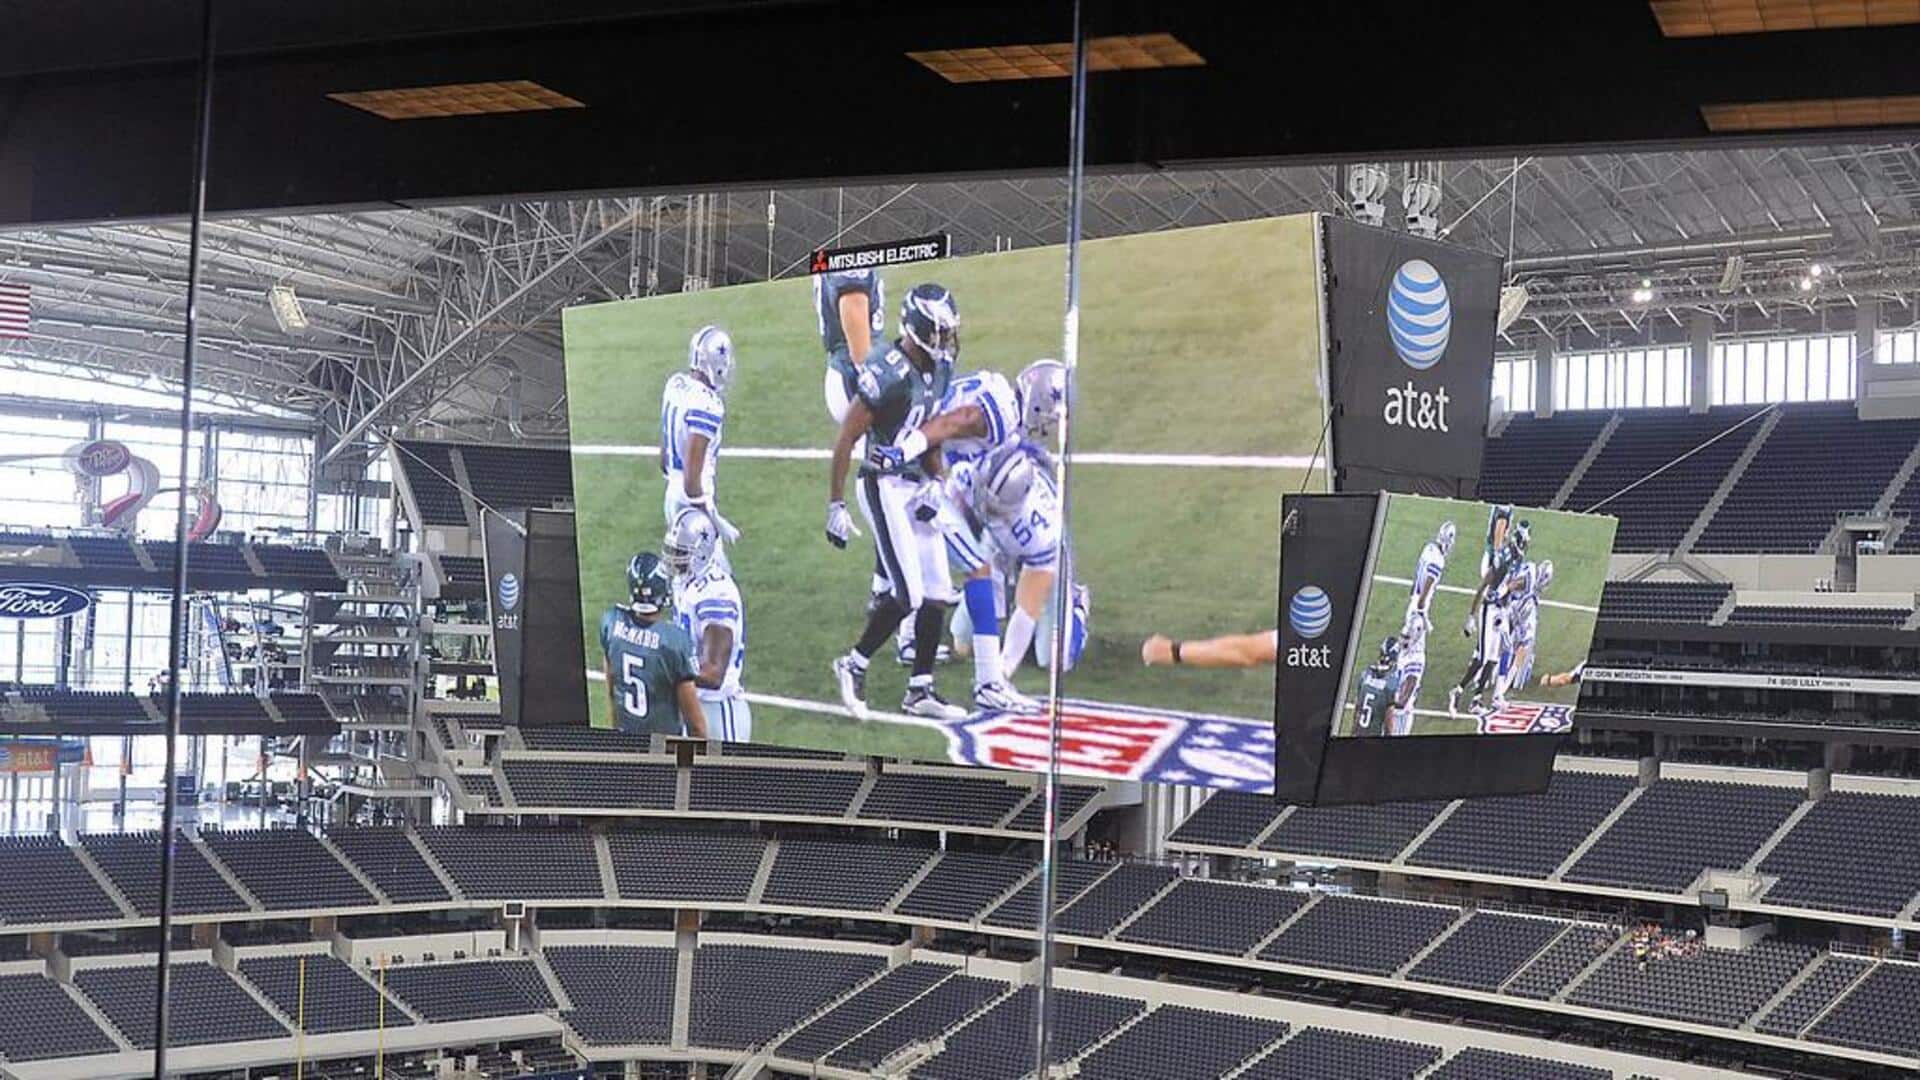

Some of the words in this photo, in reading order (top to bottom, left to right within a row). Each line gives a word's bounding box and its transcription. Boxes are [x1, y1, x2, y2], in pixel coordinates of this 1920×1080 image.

[828, 248, 885, 270] MITSUBISHI
[886, 242, 939, 263] ELECTRIC
[1383, 381, 1450, 433] at&t
[1011, 509, 1050, 547] 54
[0, 587, 68, 615] Ford
[1287, 643, 1332, 669] at&t
[622, 651, 648, 718] 5
[1799, 678, 1821, 687] LILLY
[1358, 692, 1377, 729] 5
